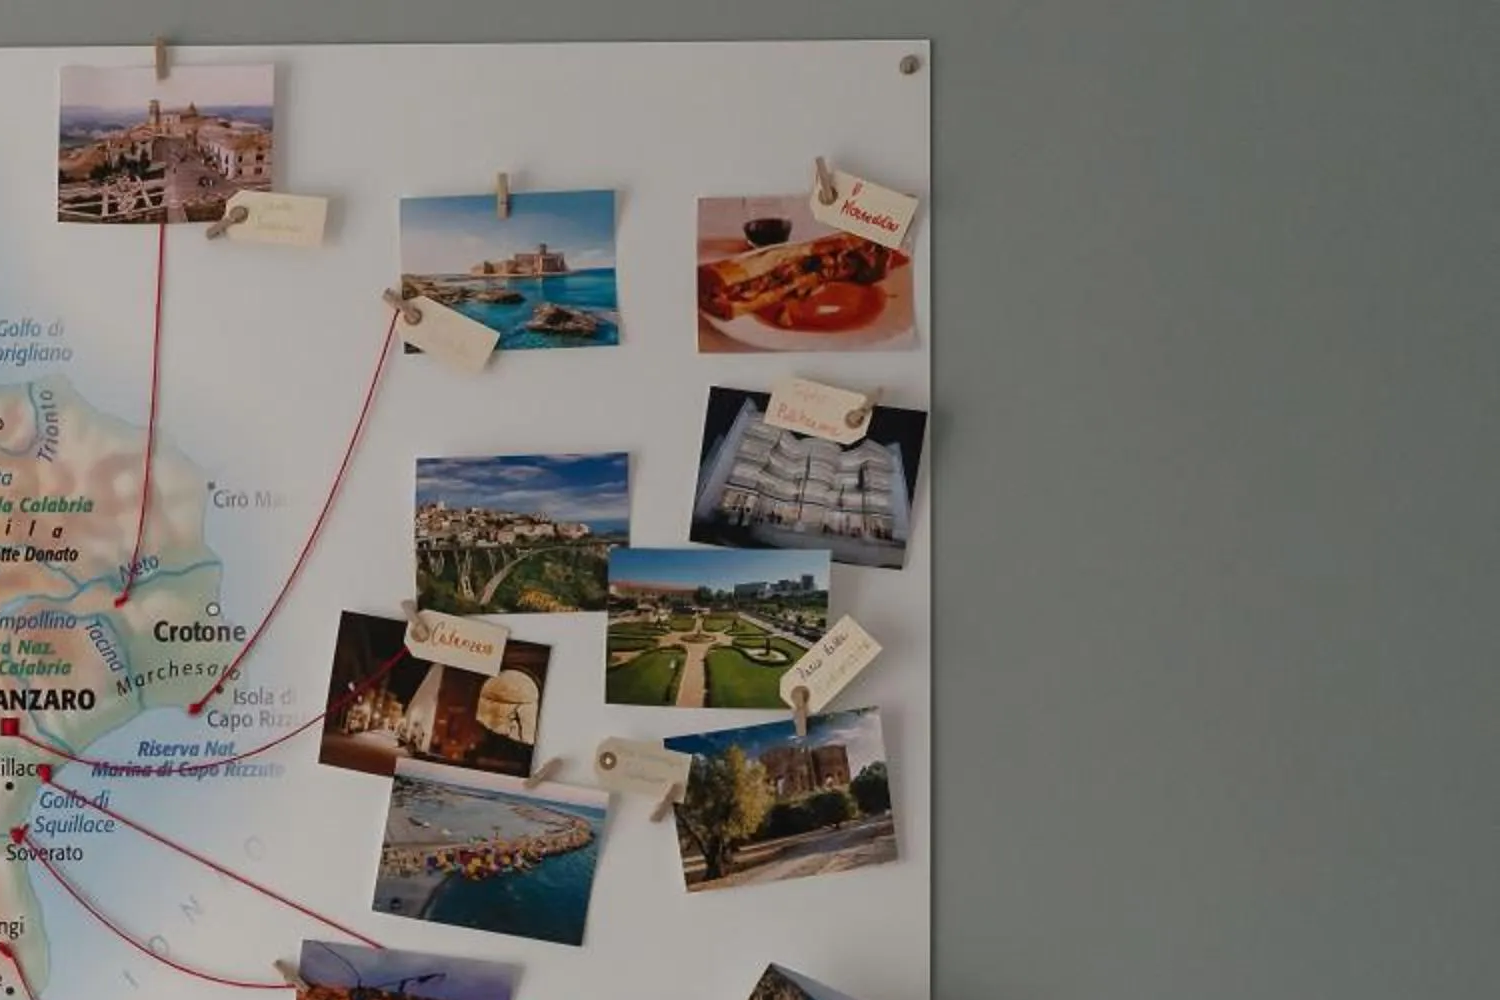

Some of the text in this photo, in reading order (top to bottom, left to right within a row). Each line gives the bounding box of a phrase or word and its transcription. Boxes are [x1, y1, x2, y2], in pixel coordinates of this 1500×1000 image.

[47, 320, 65, 337] di
[36, 389, 60, 464] Trionto
[19, 497, 95, 514] Calabria
[24, 546, 79, 563] Donato
[118, 554, 160, 583] Neto
[153, 620, 247, 643] Crotone
[17, 638, 55, 655] Naz.
[233, 686, 275, 706] Isola
[206, 710, 253, 733] Capo
[137, 740, 238, 758] Riserva Nat.
[33, 815, 116, 837] Squillace
[6, 844, 84, 862] Soverato
